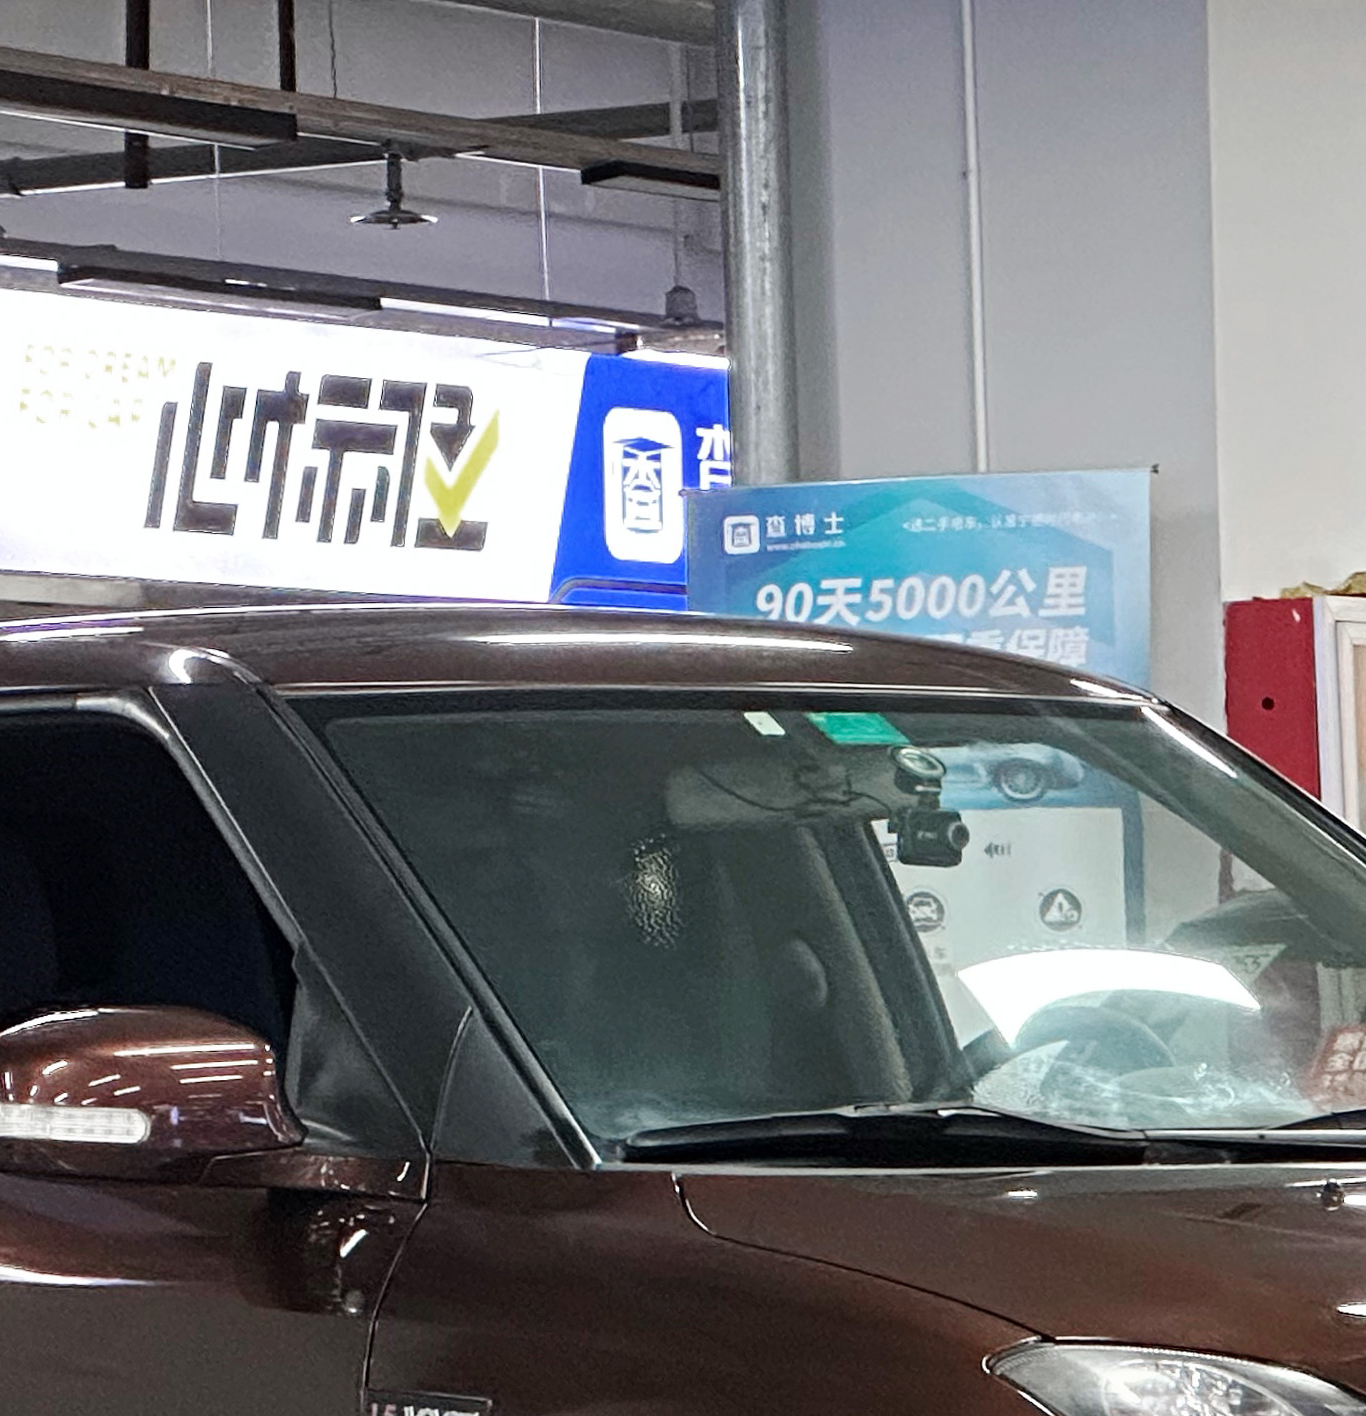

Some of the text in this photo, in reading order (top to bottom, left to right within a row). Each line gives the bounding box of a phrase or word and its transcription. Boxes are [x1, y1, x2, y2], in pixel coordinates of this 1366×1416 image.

[766, 512, 844, 538] 查博士
[755, 564, 1088, 626] 90天5000公里
